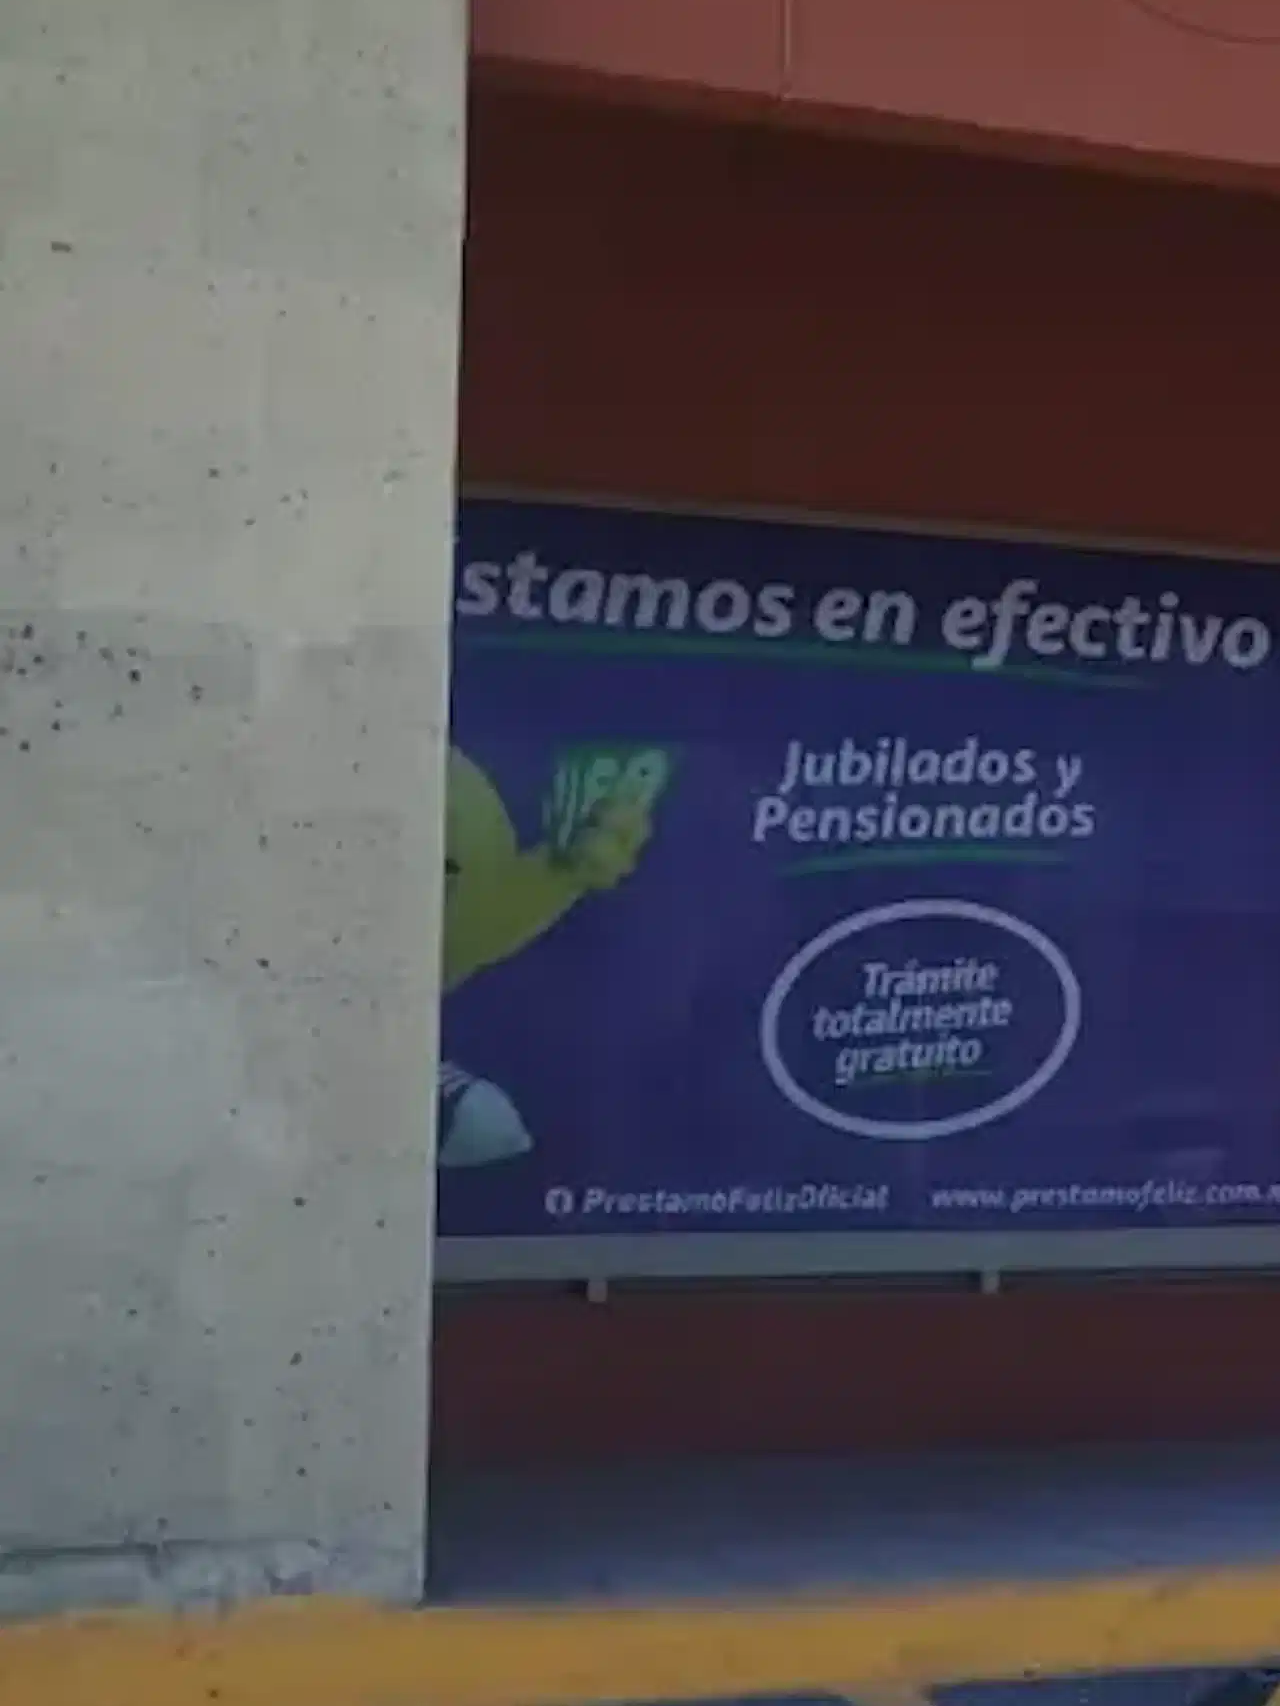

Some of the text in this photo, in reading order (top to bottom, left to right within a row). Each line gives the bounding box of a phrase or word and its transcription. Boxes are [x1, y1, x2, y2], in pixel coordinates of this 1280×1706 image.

[455, 549, 1272, 671] stamos en efectivo
[780, 737, 1084, 795] Jubilados y
[752, 791, 1098, 845] Pensionados
[862, 957, 1000, 999] Trámite
[812, 995, 1013, 1041] totalmente
[834, 1035, 982, 1086] gratuito
